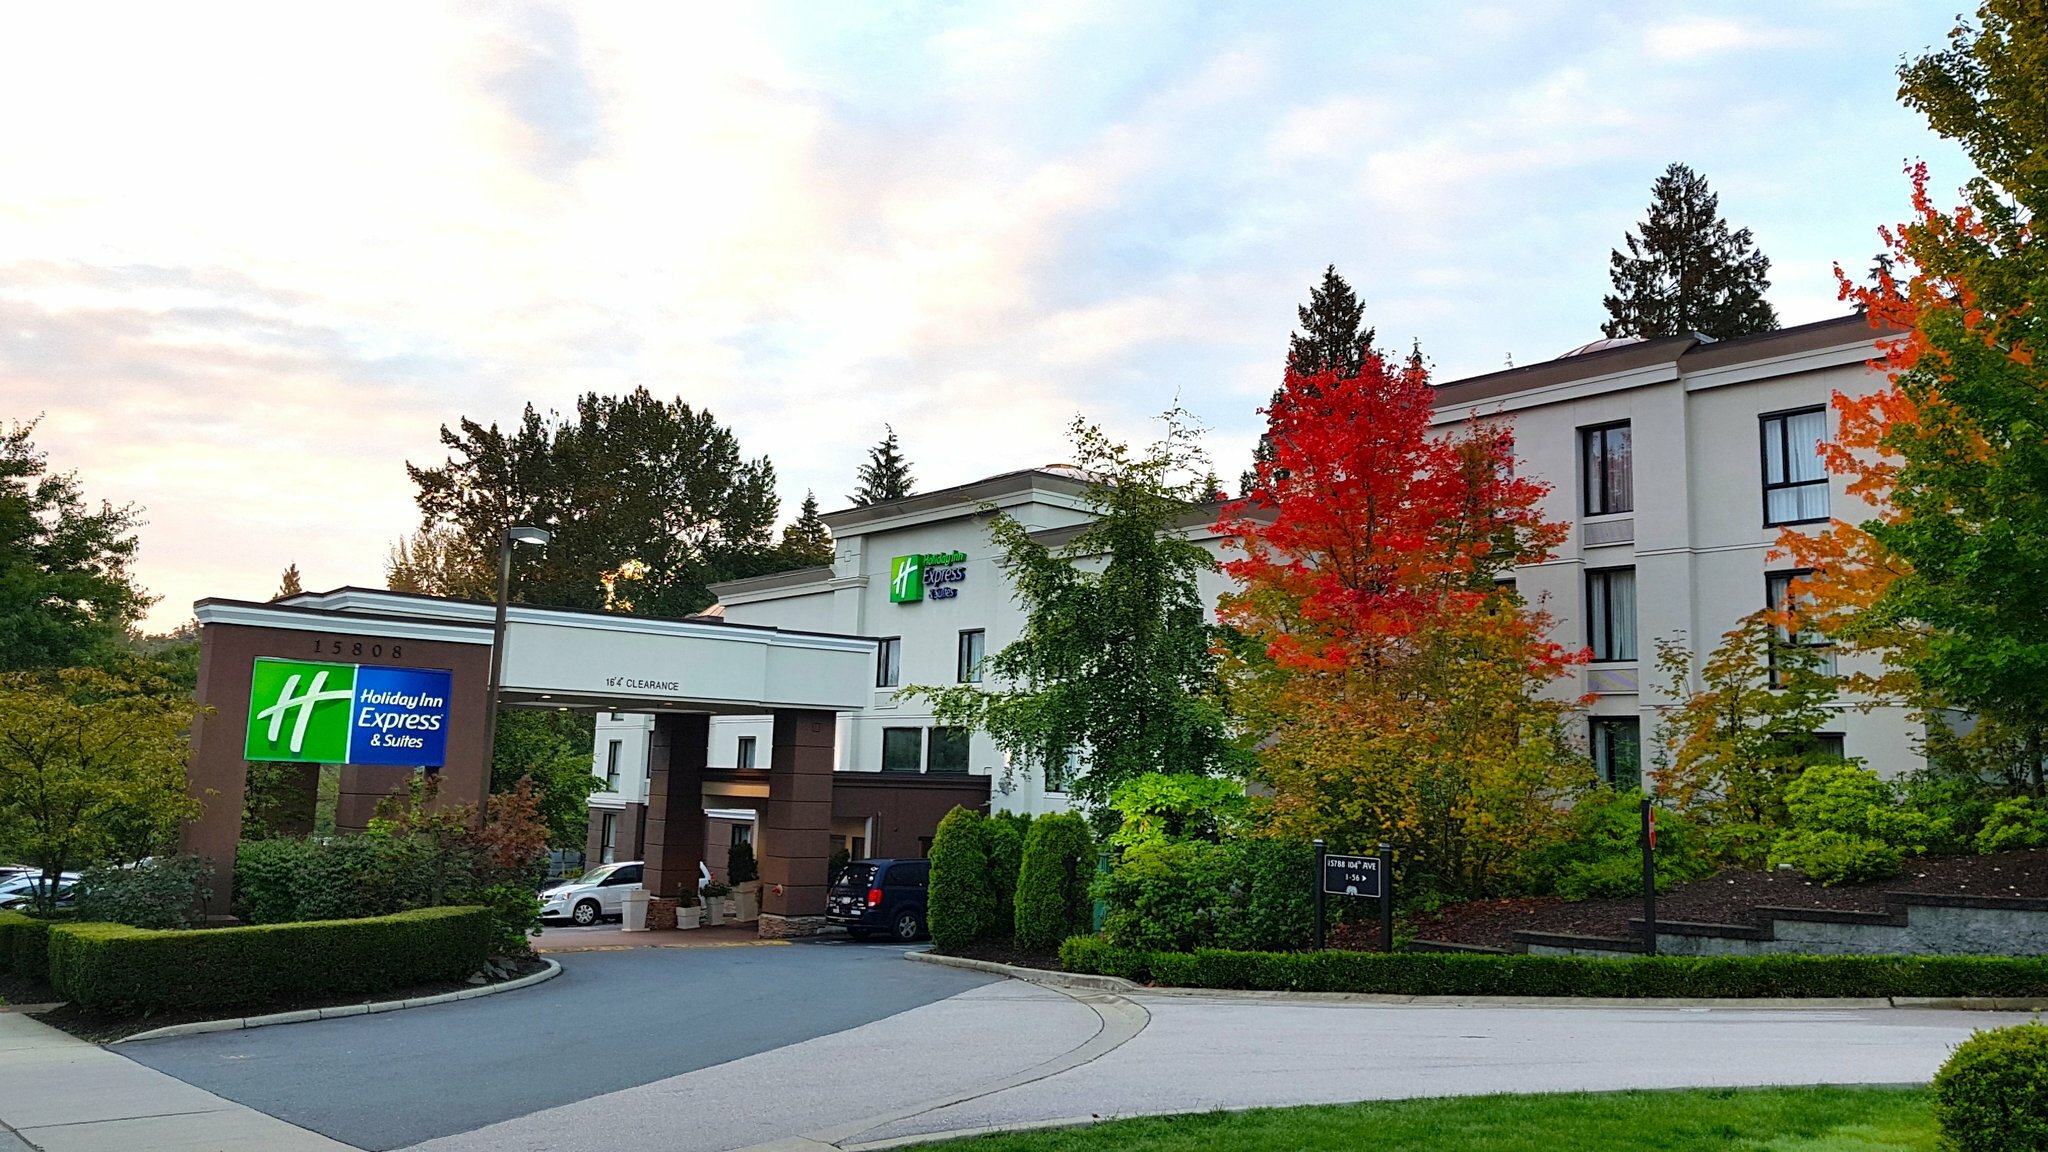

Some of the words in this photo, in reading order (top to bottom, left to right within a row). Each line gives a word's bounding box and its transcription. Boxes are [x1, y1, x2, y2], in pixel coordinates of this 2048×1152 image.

[924, 552, 952, 566] Holiday
[952, 550, 967, 562] Inn
[923, 567, 966, 587] Express
[314, 639, 402, 659] 15808
[626, 679, 679, 691] CLEARANCE
[360, 688, 418, 709] Holiday
[419, 692, 443, 708] Inn
[358, 707, 442, 733] Express
[370, 733, 381, 747] &
[382, 734, 424, 748] Suites
[1327, 859, 1346, 868] 15788
[1362, 862, 1376, 870] AVE
